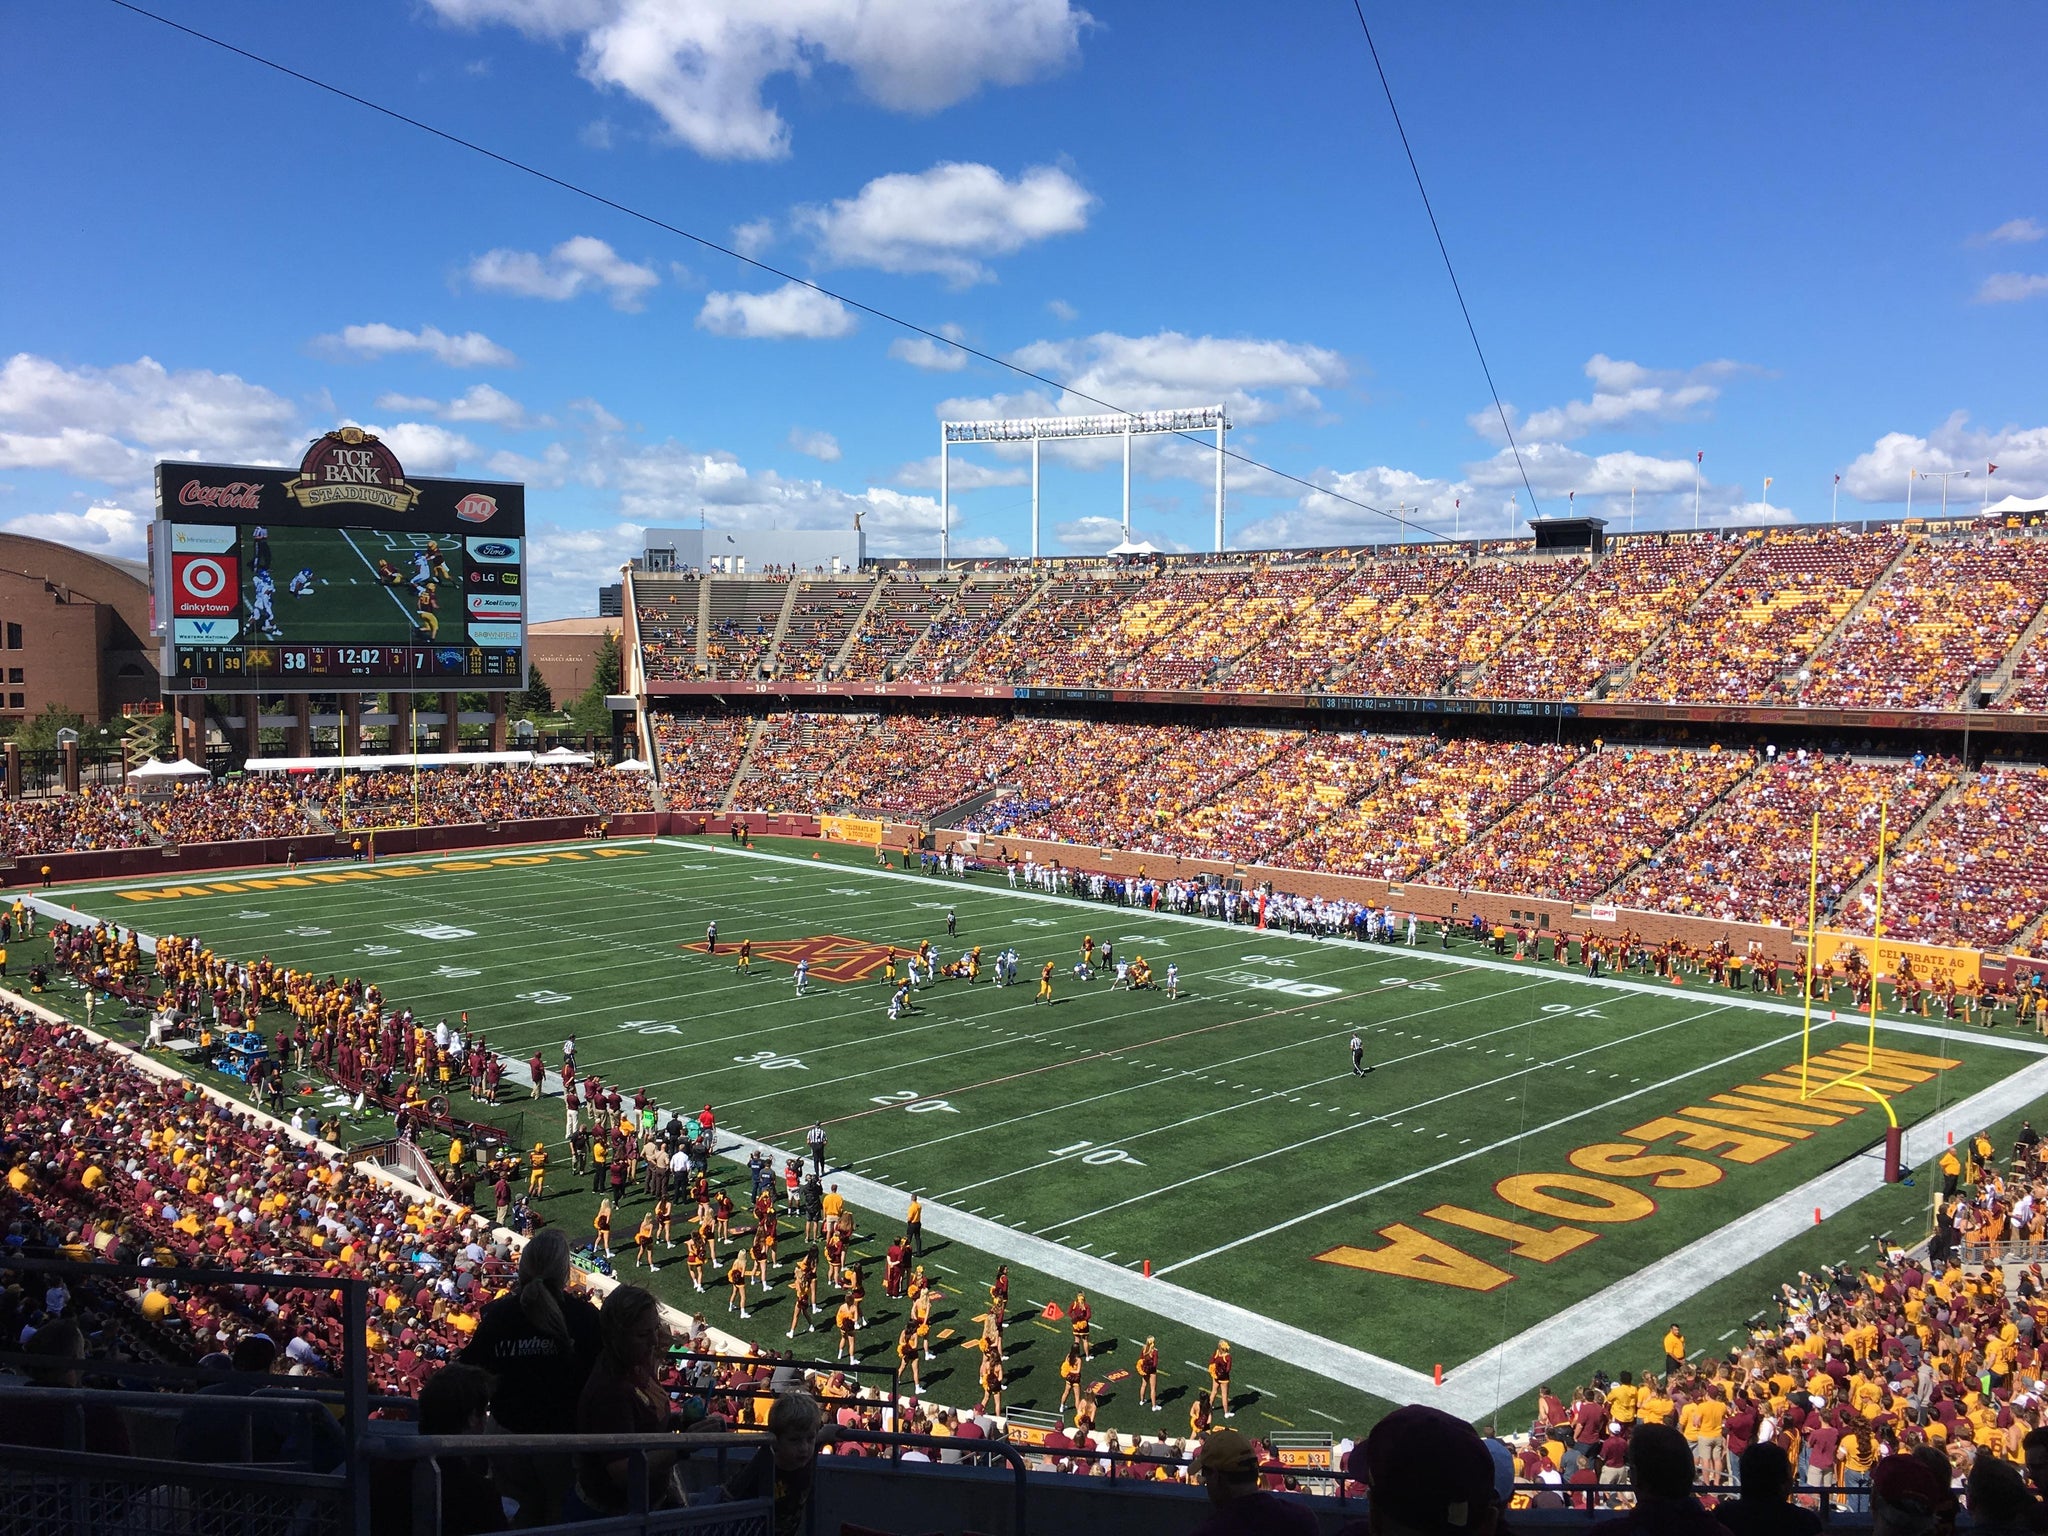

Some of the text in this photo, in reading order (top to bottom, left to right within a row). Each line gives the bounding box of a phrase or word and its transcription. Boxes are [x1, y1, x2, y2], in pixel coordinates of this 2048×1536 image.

[333, 449, 373, 467] TCF
[324, 464, 382, 484] BANK
[179, 479, 264, 509] Coca-Cola
[309, 486, 398, 507] STADIUM
[464, 500, 490, 517] DQ
[483, 545, 506, 556] Ford
[482, 573, 495, 582] LG
[180, 603, 230, 612] dinkytown
[284, 652, 306, 669] 38
[315, 655, 321, 664] 3
[337, 649, 380, 664] 12:02
[393, 654, 399, 664] 3
[415, 653, 424, 669] 7
[183, 657, 191, 669] 4
[206, 657, 212, 669] 1
[225, 657, 240, 669] 39
[755, 684, 766, 693] 10
[816, 684, 827, 693] 15
[874, 685, 886, 694] 54
[930, 686, 942, 695] 72
[983, 687, 994, 696] 78
[1326, 698, 1336, 708] 38
[1354, 699, 1374, 709] 12:02
[1413, 700, 1418, 711] 7
[1498, 703, 1507, 714] 21
[1544, 704, 1550, 715] 8
[114, 848, 650, 901] MINNESOTA
[1593, 909, 1614, 917] ESPN
[1879, 949, 1945, 965] CELBRATE
[1949, 957, 1965, 968] AG
[1887, 960, 1894, 969] &
[515, 990, 573, 1004] 50
[617, 1020, 678, 1034] 40
[733, 1051, 803, 1069] 30
[869, 1090, 952, 1113] 20
[1047, 1140, 1135, 1165] 10
[1311, 1043, 1963, 1292] MINNESOTA
[1047, 1305, 1055, 1316] G
[1107, 1369, 1129, 1381] GOLD
[1510, 1494, 1530, 1509] 27
